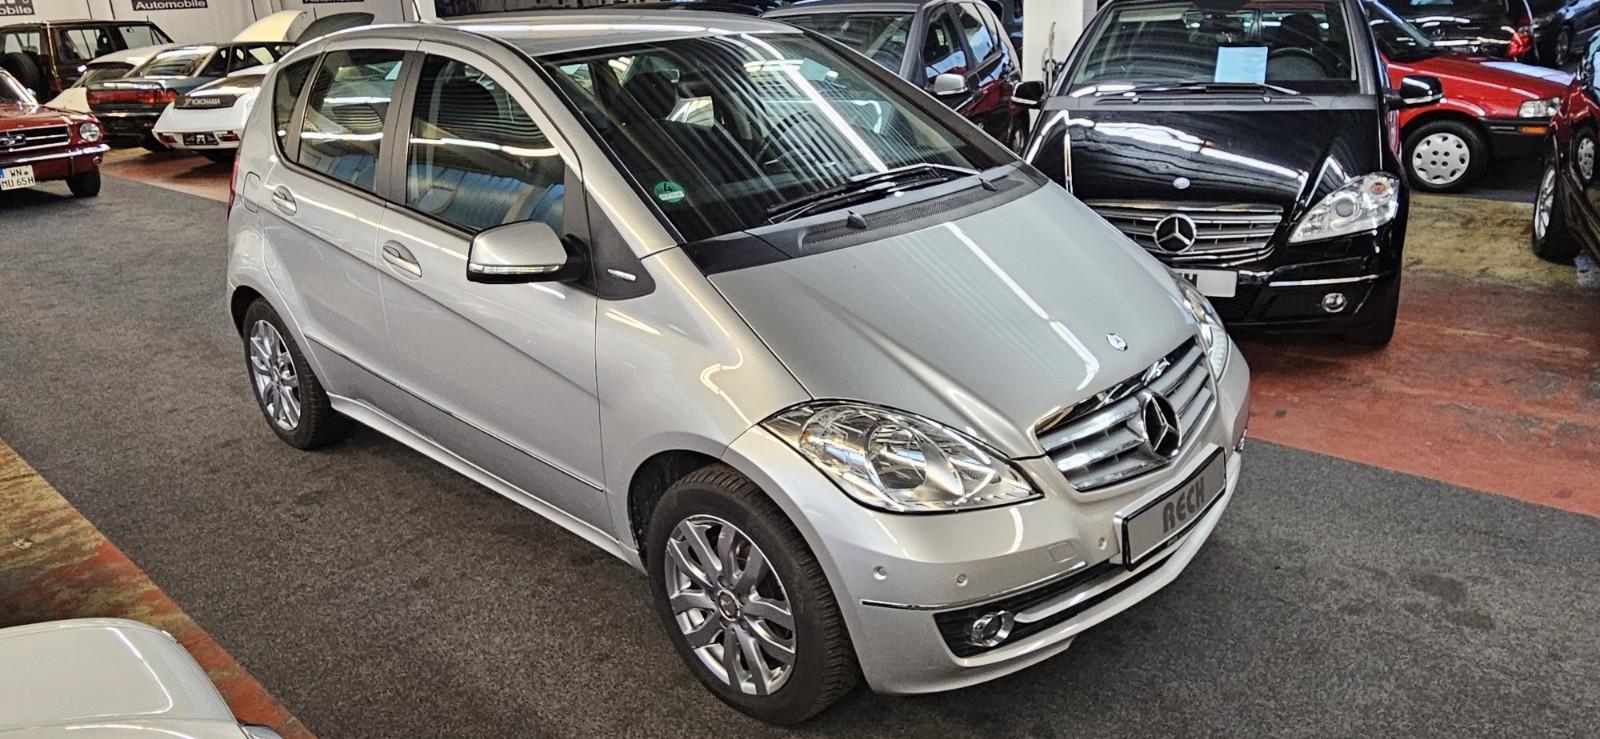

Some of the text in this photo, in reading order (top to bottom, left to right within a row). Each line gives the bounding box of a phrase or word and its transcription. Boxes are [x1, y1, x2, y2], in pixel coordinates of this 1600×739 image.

[135, 0, 206, 10] Automobile
[10, 169, 22, 177] WN
[1163, 477, 1204, 533] RECH
